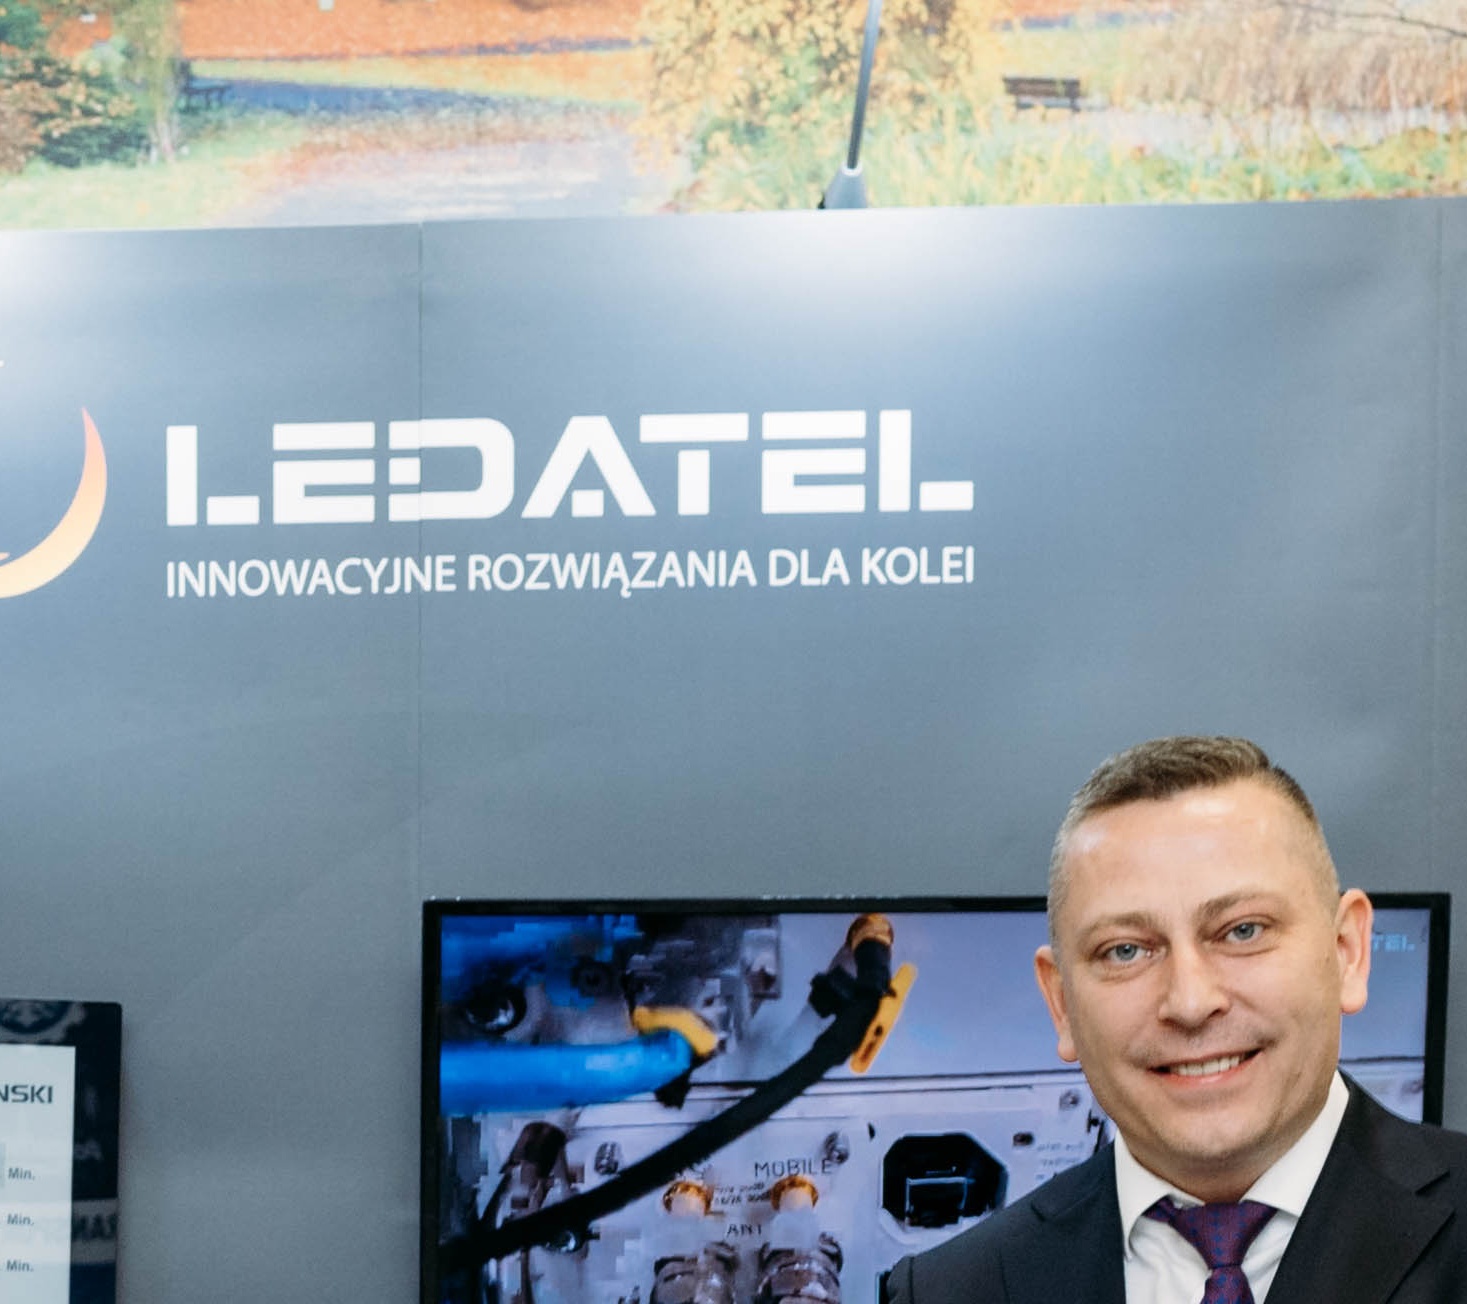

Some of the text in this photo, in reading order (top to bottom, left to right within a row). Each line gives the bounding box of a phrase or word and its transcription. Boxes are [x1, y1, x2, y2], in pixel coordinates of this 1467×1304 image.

[165, 409, 975, 526] LEDATEL
[165, 545, 975, 599] INNOWACYJNE ROZWIĄZANIA DLA KOLEI
[7, 1166, 36, 1180] Min.
[6, 1213, 35, 1226] Min.
[6, 1259, 34, 1273] Min.
